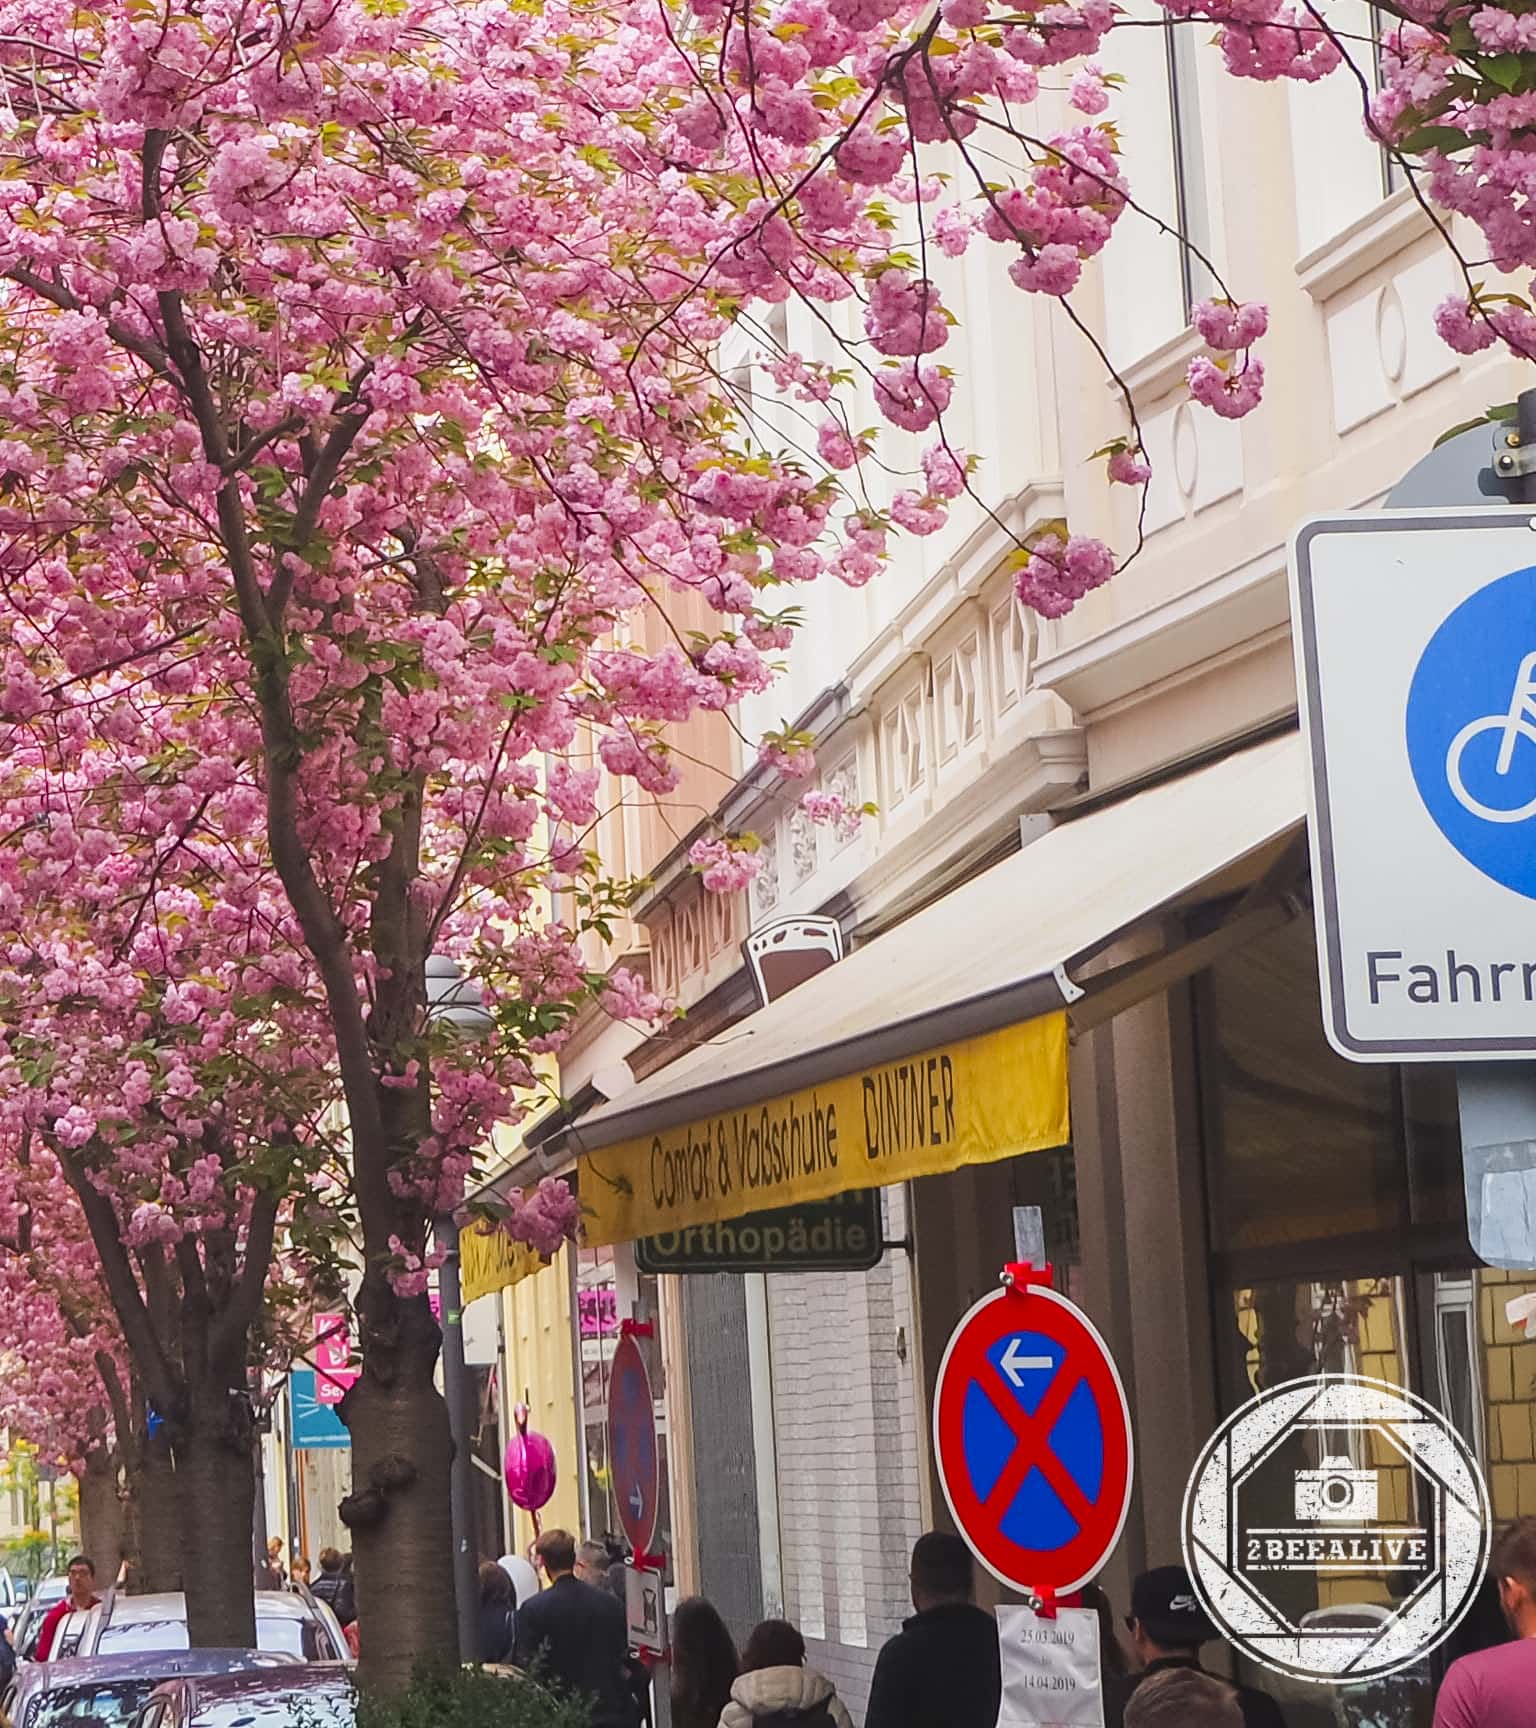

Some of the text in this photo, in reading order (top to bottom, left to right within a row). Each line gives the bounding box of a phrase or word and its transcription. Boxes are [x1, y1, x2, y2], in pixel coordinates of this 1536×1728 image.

[718, 1120, 732, 1195] &
[862, 1056, 955, 1159] DINTNER
[654, 1217, 866, 1260] Orthopädie
